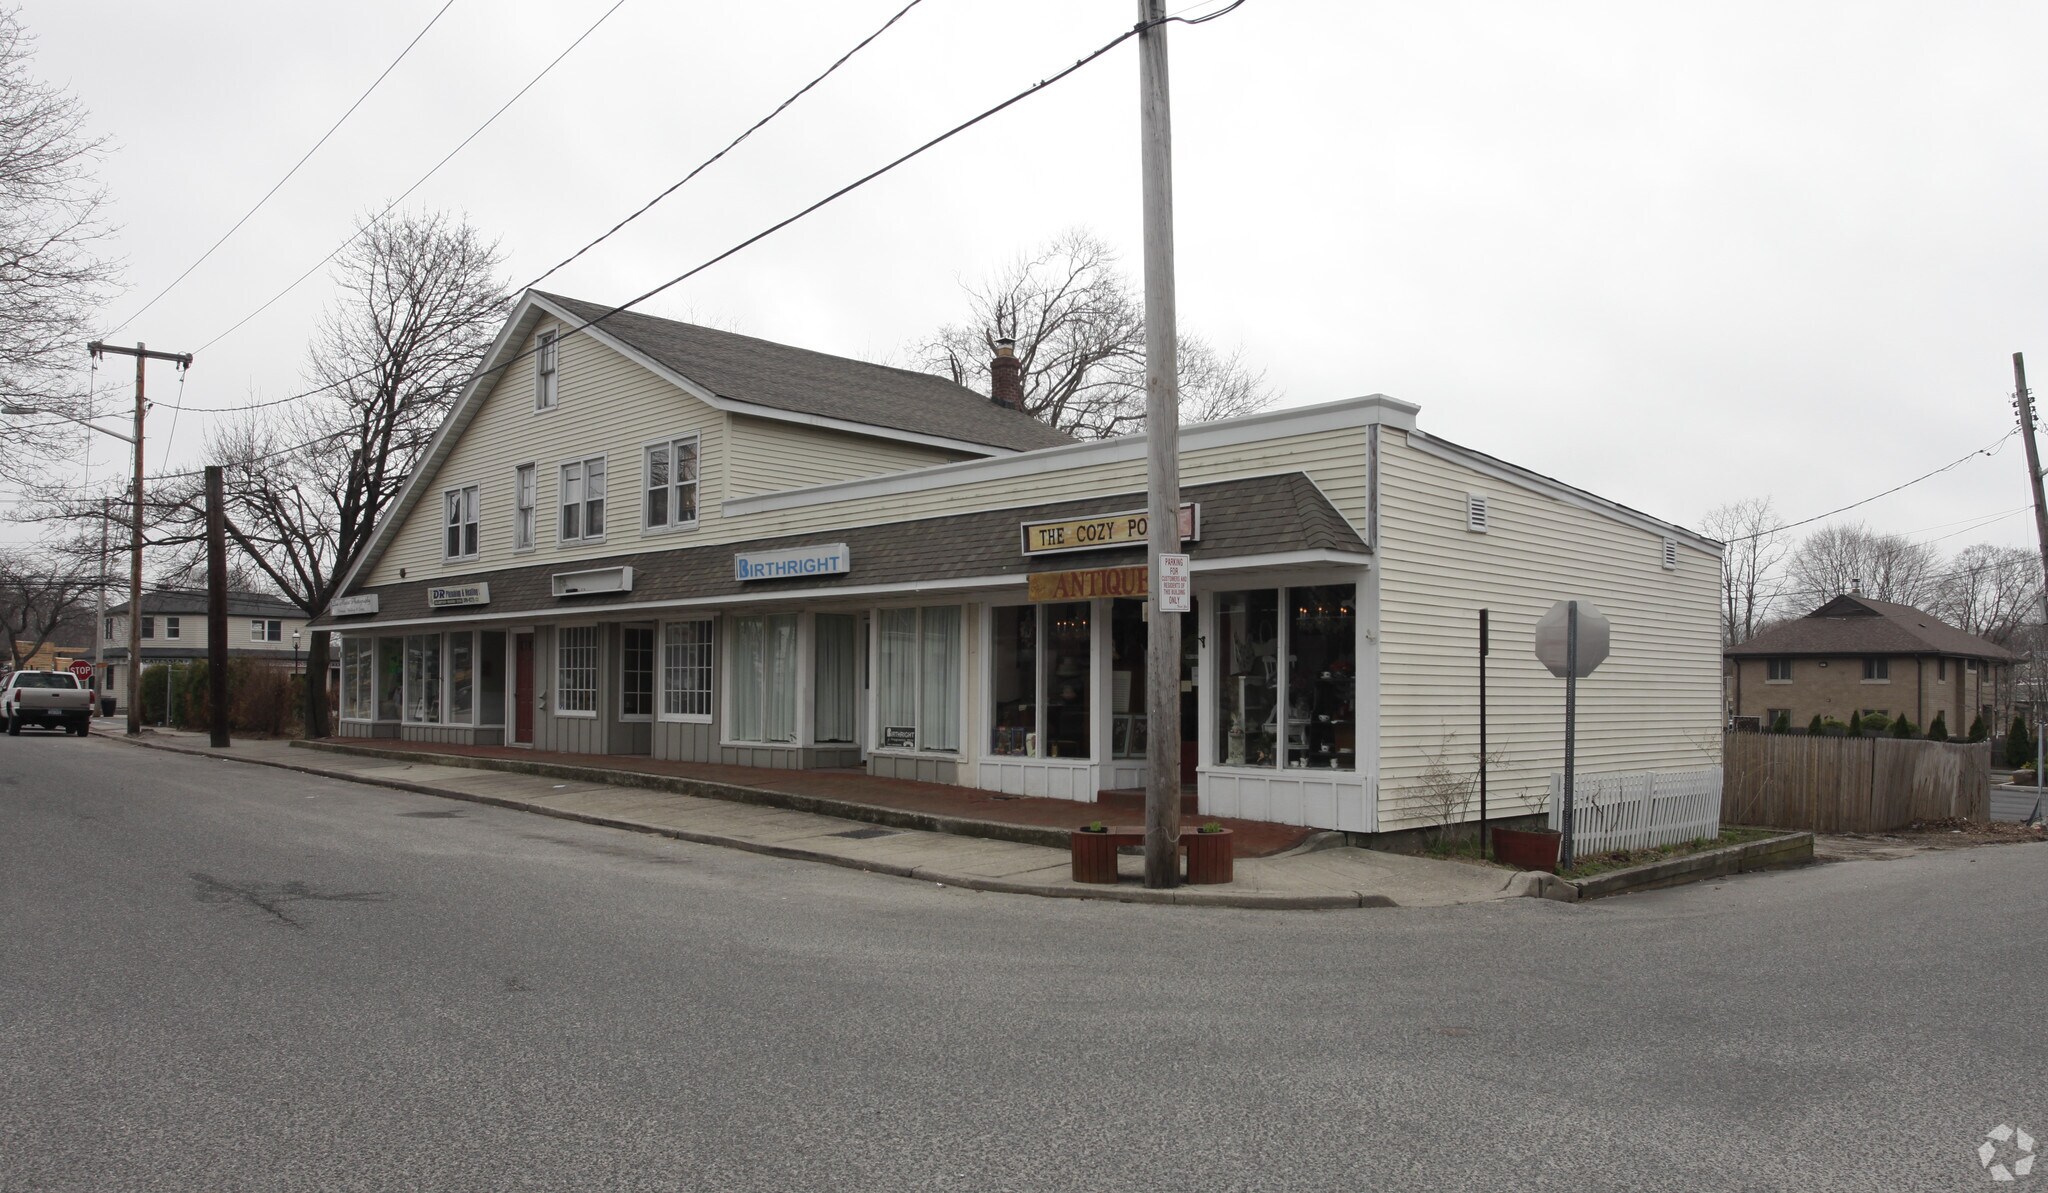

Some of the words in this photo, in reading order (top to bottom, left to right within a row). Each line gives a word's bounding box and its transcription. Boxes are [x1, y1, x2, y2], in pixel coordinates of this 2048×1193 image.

[1039, 527, 1065, 546] THE
[1076, 522, 1114, 542] COZY
[1127, 517, 1149, 537] PO
[1165, 557, 1183, 566] PARKING
[738, 556, 840, 578] BIRTHRIGHT
[1170, 567, 1178, 575] FOR
[1054, 566, 1148, 598] ANTIQUE
[433, 589, 445, 599] DR
[1168, 596, 1180, 605] ONLY
[70, 666, 91, 675] STOP
[886, 727, 915, 738] BIRTHRIGHT
